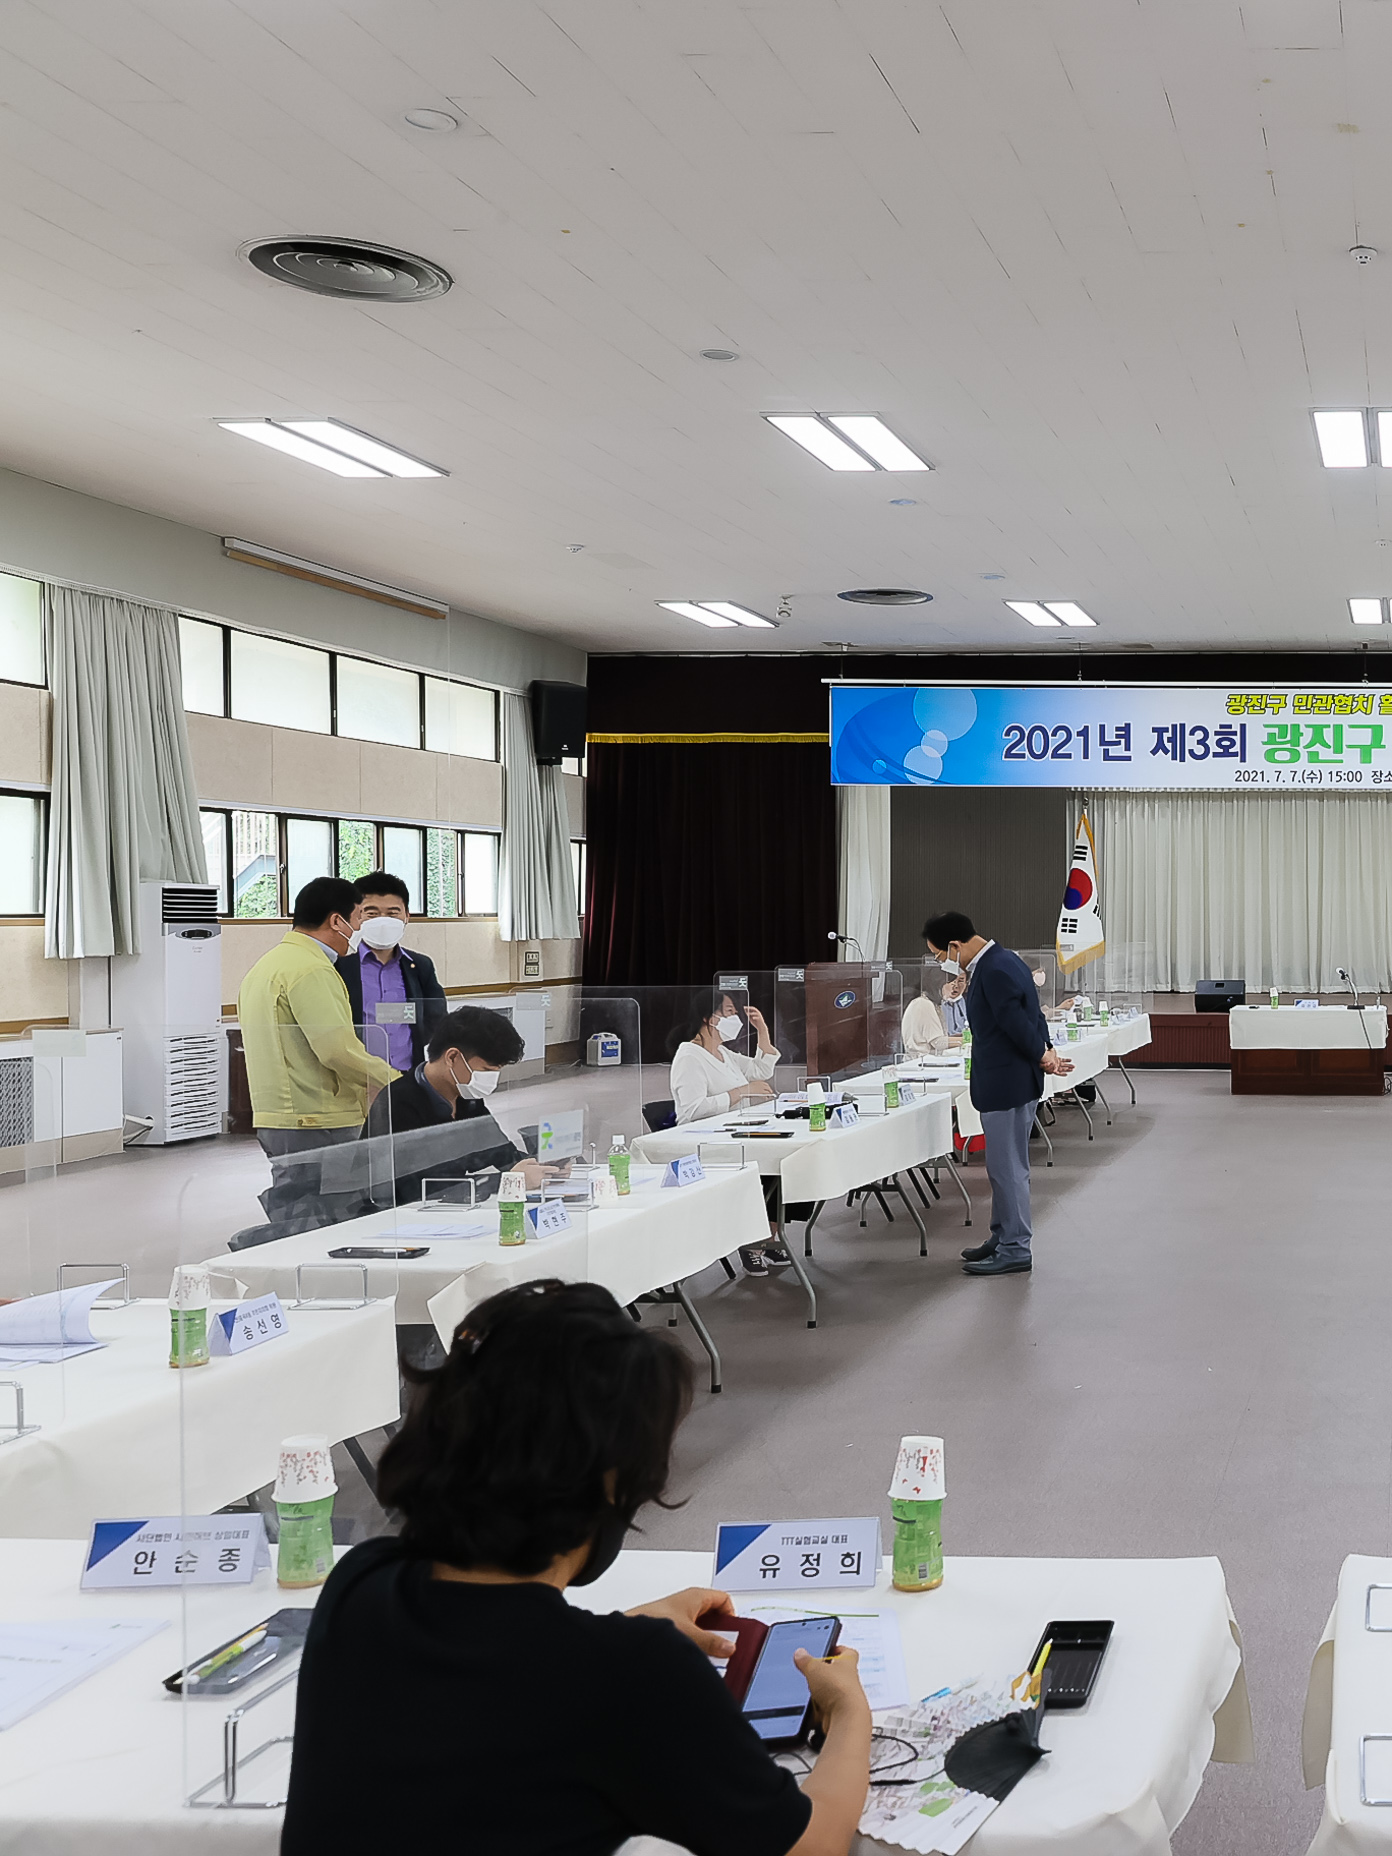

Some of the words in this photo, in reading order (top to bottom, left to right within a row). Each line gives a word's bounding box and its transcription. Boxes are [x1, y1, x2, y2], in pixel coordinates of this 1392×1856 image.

[1226, 694, 1287, 715] 광진구
[1292, 694, 1375, 715] 민관협치
[1002, 723, 1133, 762] 2021년
[1150, 723, 1247, 763] 제3회
[1261, 724, 1387, 764] 광진구
[1234, 770, 1270, 783] 2021.
[1328, 770, 1363, 783] 15:00
[831, 1534, 849, 1544] 대표
